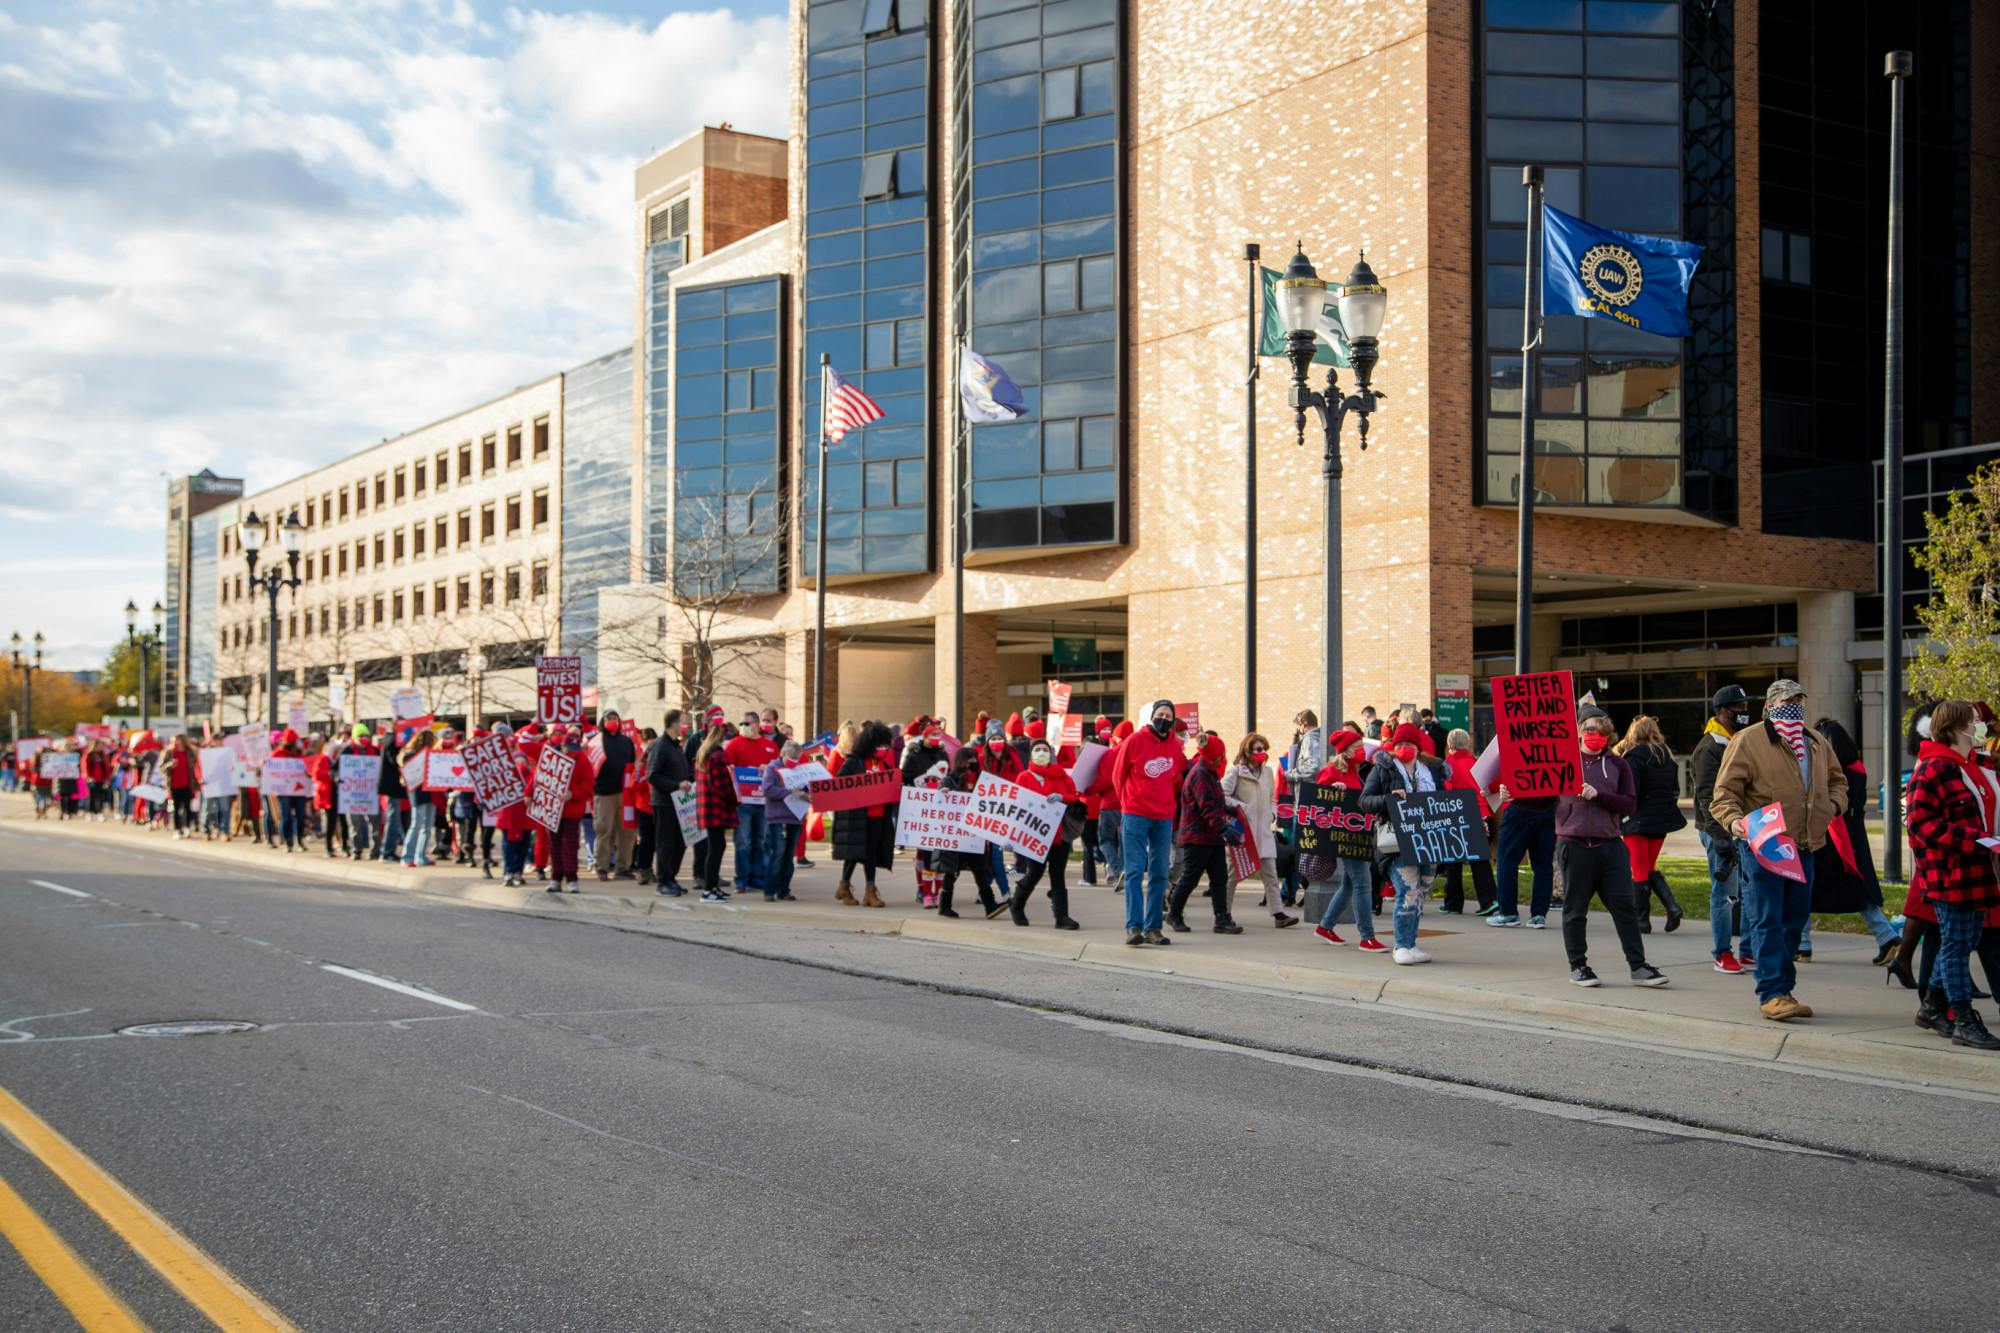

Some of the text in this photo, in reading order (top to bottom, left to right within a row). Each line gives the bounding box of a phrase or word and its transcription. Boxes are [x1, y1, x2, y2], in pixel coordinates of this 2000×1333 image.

[1599, 267, 1625, 285] UAW
[1614, 310, 1640, 329] 4911
[538, 670, 580, 686] INVEST
[1503, 675, 1563, 698] BETTER
[540, 694, 580, 723] US!
[1504, 695, 1567, 718] PAY AND
[1508, 720, 1569, 742] NURSES
[463, 735, 506, 766] SAFE
[1519, 743, 1567, 765] WILL
[471, 755, 515, 780] WORK
[542, 750, 571, 782] SAFE
[1514, 761, 1575, 793] STAY!
[477, 770, 517, 797] FAIR
[537, 771, 566, 796] WORK
[812, 770, 894, 793] SOLIDARITY
[977, 783, 1019, 800] SAFE
[482, 781, 524, 810] WAGE
[533, 787, 560, 812] FAIR
[907, 791, 935, 802] LAST
[1317, 788, 1346, 802] STAFF
[1427, 796, 1463, 816] Praise
[530, 801, 558, 830] WAGE
[903, 820, 930, 833] THIS
[921, 808, 961, 822] HEROE
[978, 799, 1051, 837] STAFFING
[1420, 816, 1452, 830] deserve
[1458, 815, 1465, 825] a
[920, 836, 959, 849] ZEROS
[964, 812, 1049, 858] SAVES LIVES
[1299, 838, 1318, 850] the
[1302, 827, 1315, 838] to
[1411, 824, 1480, 863] RAISE
